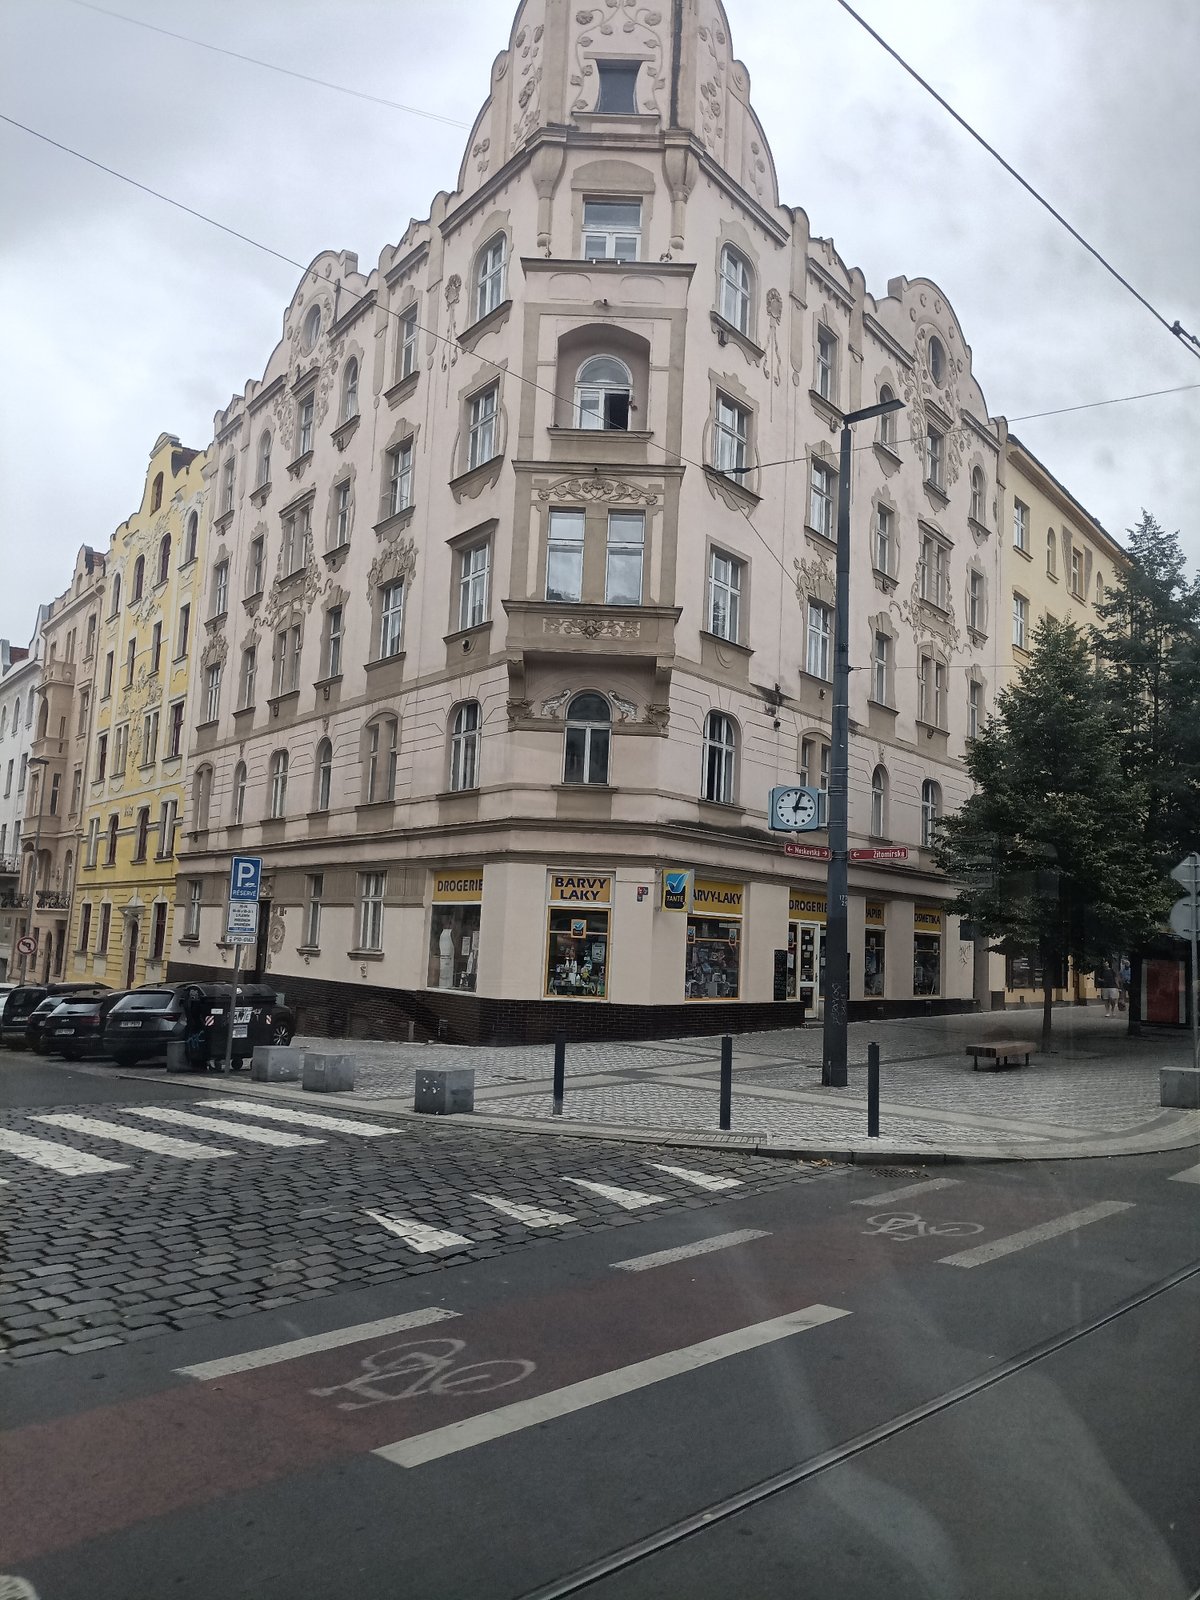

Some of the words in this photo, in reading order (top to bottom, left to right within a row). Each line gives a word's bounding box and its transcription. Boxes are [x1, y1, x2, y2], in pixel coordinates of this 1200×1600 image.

[236, 862, 255, 887] P
[437, 878, 483, 892] DROGERIE
[555, 877, 607, 889] BARVY
[560, 889, 601, 900] LAKY
[666, 895, 684, 903] TANTE
[693, 888, 742, 904] ARVY-LAKY
[789, 899, 828, 913] DROGERIE
[866, 907, 882, 919] APÍR
[914, 912, 941, 925] OSMETIKA
